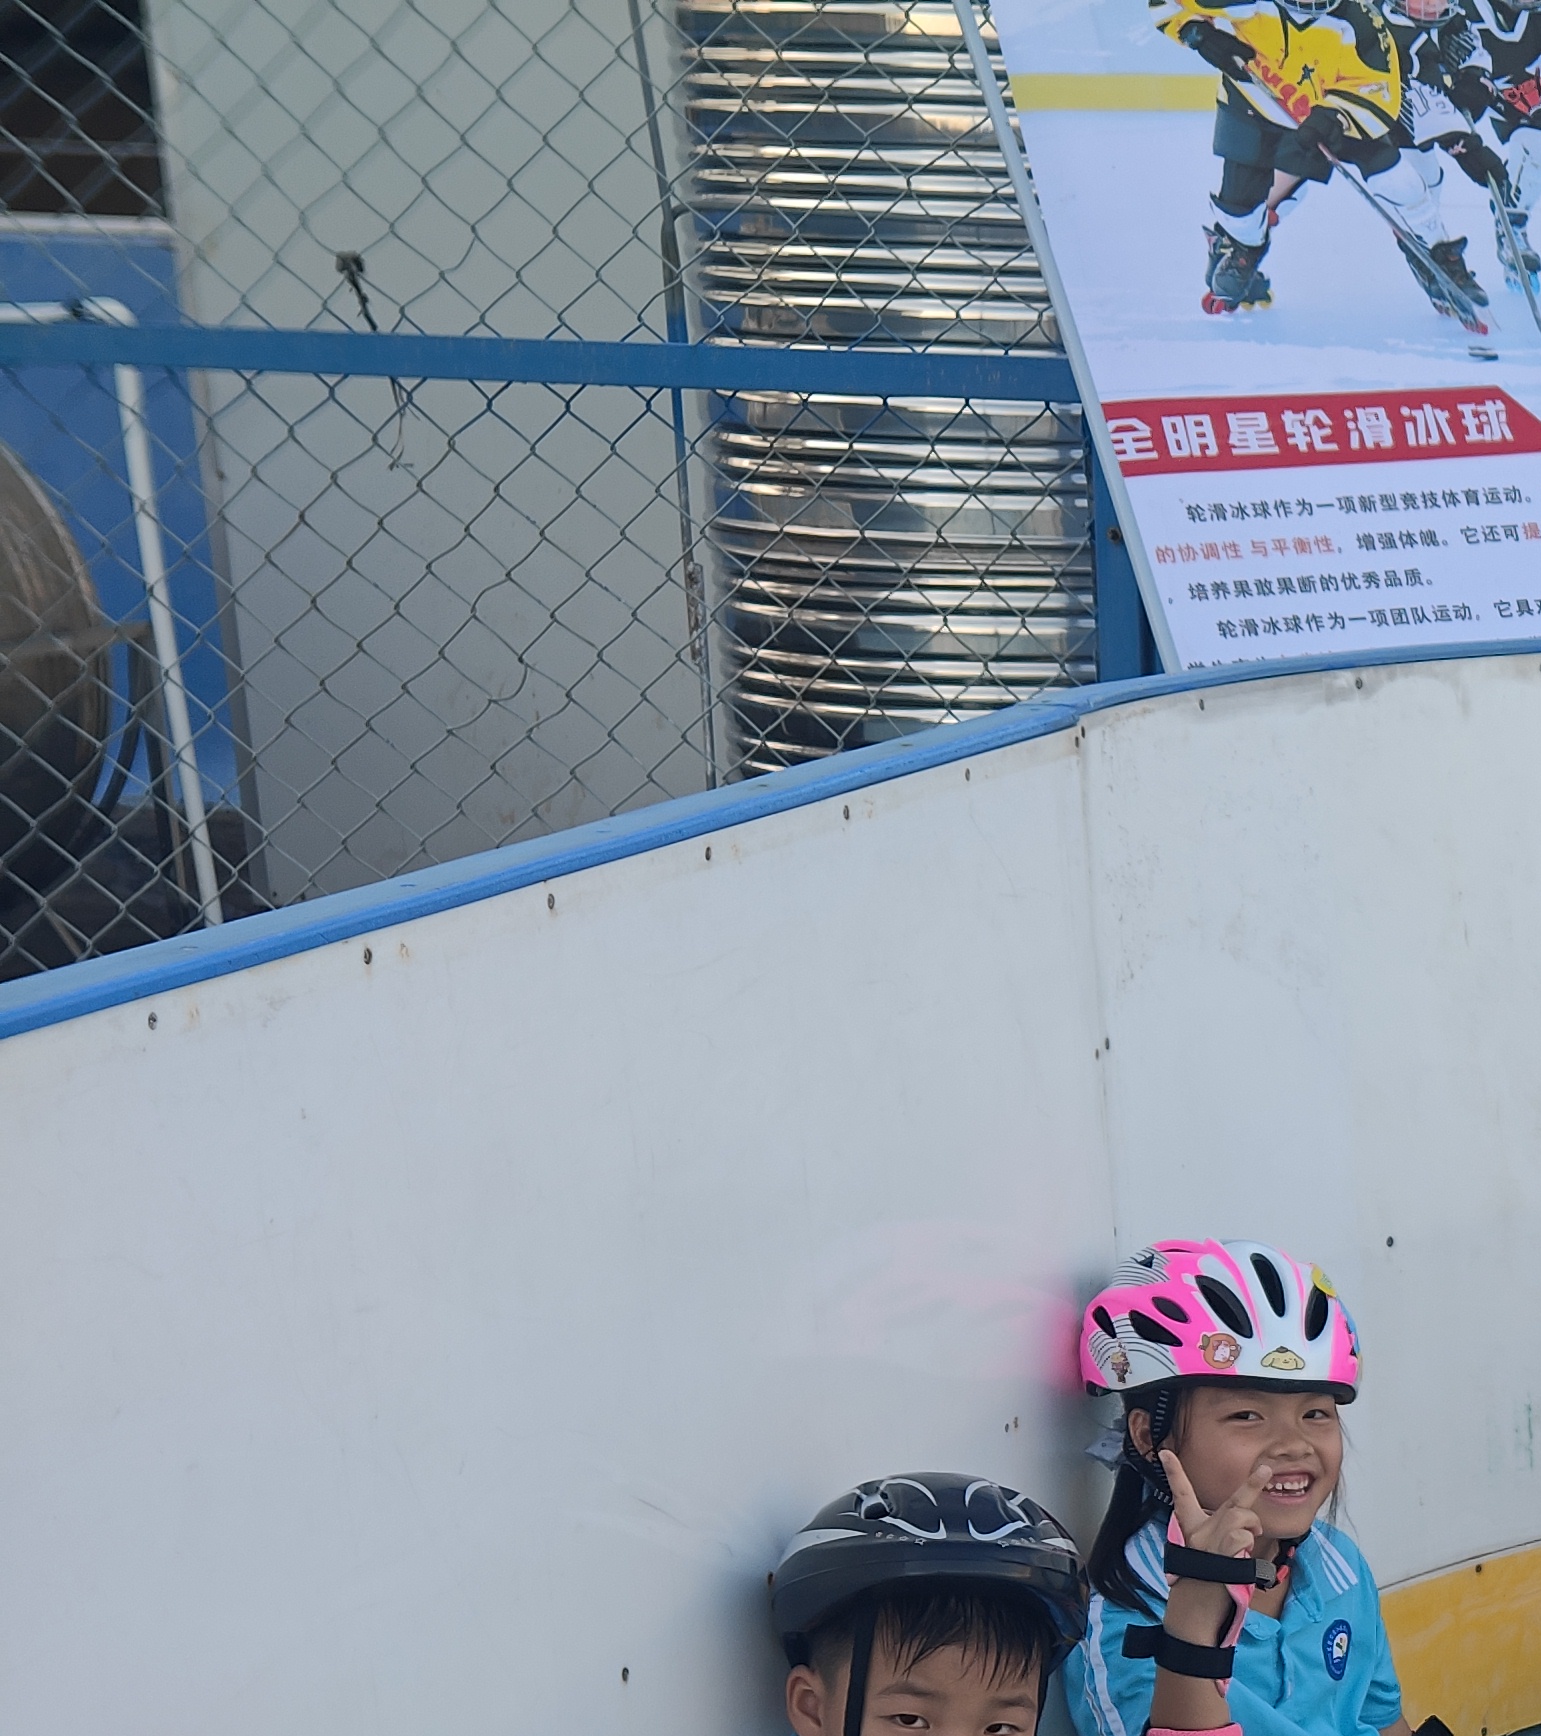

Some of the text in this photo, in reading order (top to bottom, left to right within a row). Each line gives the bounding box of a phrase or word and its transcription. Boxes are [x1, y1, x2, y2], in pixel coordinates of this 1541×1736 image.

[1106, 399, 1514, 462] 全明星轮滑冰球
